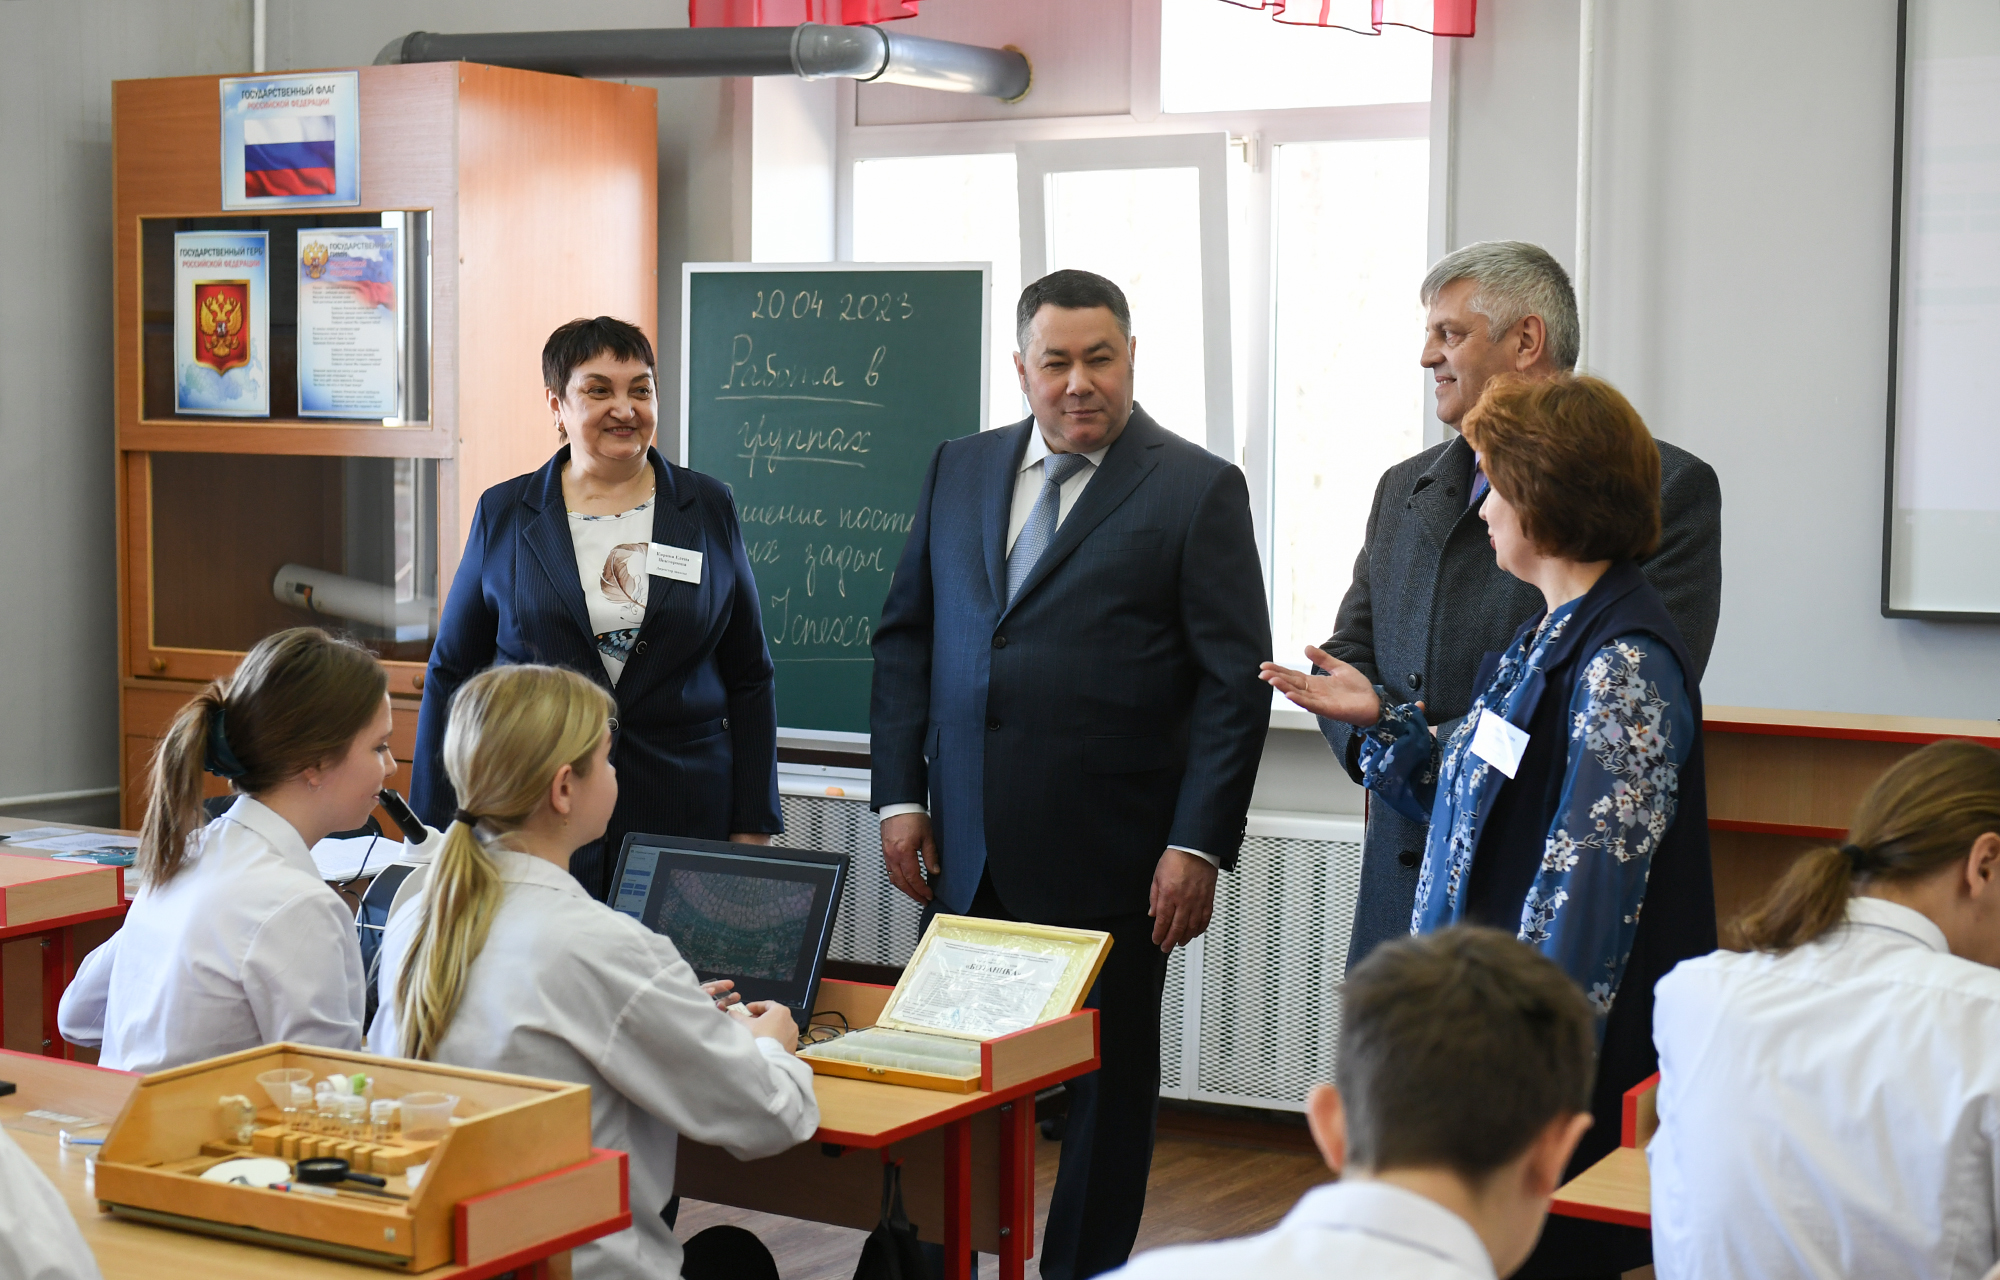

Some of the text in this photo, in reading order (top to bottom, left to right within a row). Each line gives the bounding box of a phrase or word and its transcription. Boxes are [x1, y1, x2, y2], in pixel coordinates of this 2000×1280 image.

[241, 84, 336, 99] ГОСУДАРСТВЕННЫЙ ФЛАГ
[247, 98, 330, 110] РОССИЙСКОЙ ФЕДЕРАЦИИ
[180, 246, 263, 257] ГОСУДАРСТВЕННЫЙ ГЕРБ
[329, 242, 393, 250] ГОСУДАРСТВЕННЫЙ
[182, 259, 261, 268] РОССИЙСКОЙ ФЕДЕРАЦИИ
[865, 345, 886, 387] в
[738, 414, 871, 478] группах
